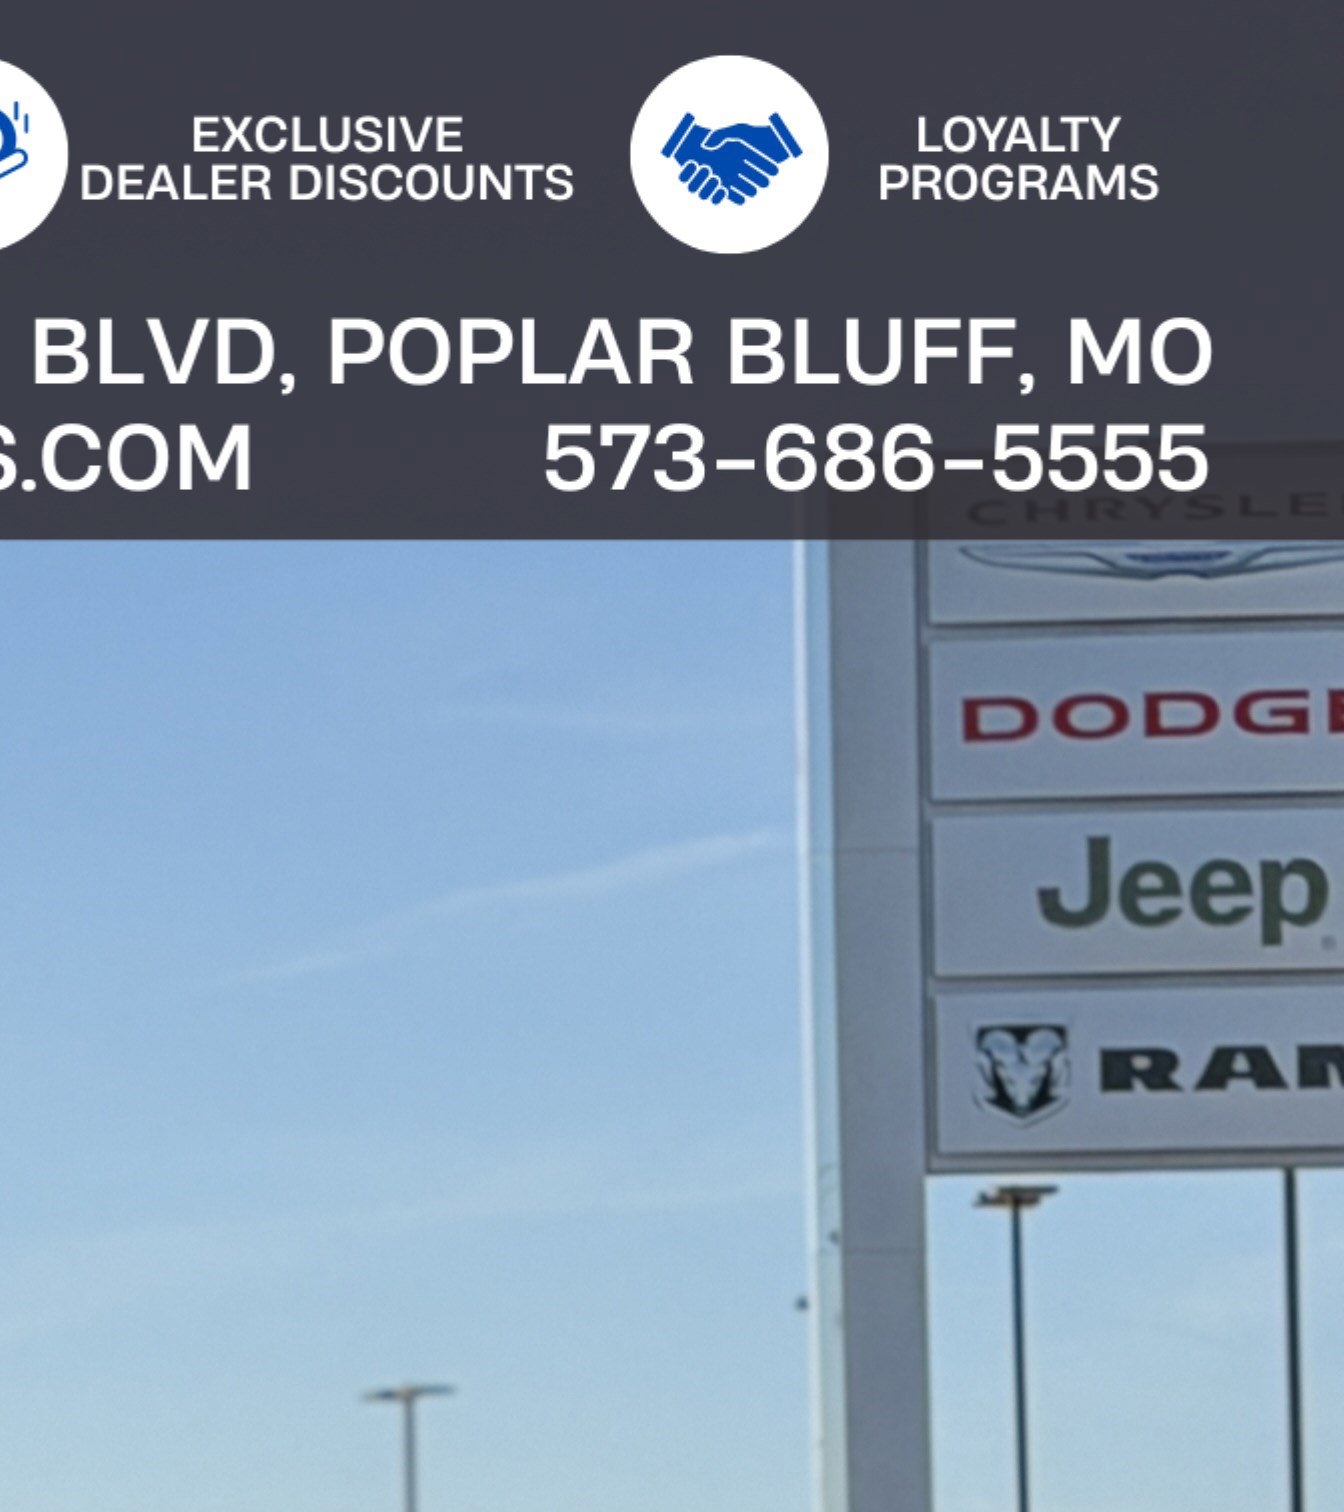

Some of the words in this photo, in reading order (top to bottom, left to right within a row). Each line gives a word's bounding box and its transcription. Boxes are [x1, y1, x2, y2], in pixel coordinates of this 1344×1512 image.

[965, 491, 1344, 527] CHRYSLE
[961, 688, 1344, 743] DODG
[1036, 835, 1330, 947] Jeep
